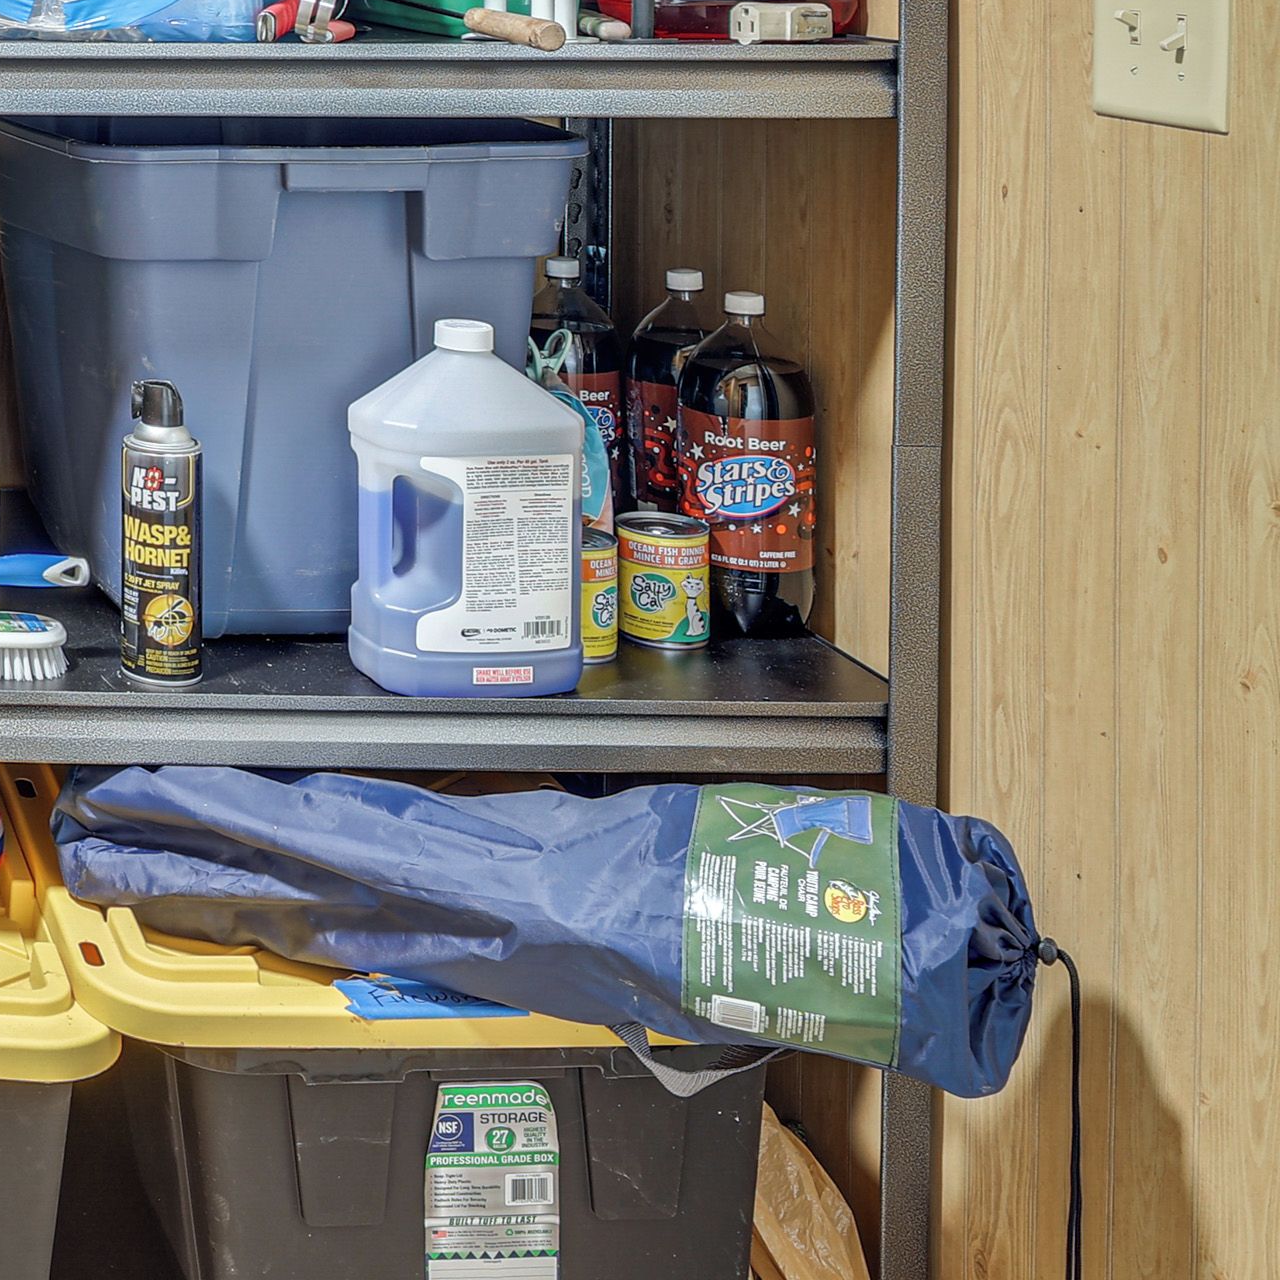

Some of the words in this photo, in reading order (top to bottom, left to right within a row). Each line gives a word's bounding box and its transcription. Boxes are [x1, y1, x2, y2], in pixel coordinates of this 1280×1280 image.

[580, 390, 610, 402] Beer
[704, 431, 744, 448] Root
[748, 438, 786, 451] Beer
[132, 466, 176, 491] NO-
[697, 460, 766, 492] Stars
[767, 458, 790, 482] &
[131, 487, 179, 512] PEST
[705, 480, 796, 515] Stripes
[124, 514, 191, 546] WASP&
[125, 538, 191, 568] HORNET
[628, 542, 655, 554] OCEAN
[659, 546, 678, 556] FISH
[634, 552, 660, 563] MINCE
[678, 556, 702, 565] GRAVY
[590, 560, 612, 568] OCEAN
[143, 579, 155, 587] JET
[156, 581, 179, 590] SPRAY
[638, 591, 663, 608] Cat
[755, 861, 767, 880] POUR
[780, 864, 789, 896] FAUTEUIL
[766, 867, 780, 902] CAMPING
[798, 879, 806, 902] CHAIR
[806, 871, 819, 892] YOUTH
[753, 880, 766, 904] JEUNE
[779, 898, 788, 910] DE
[805, 893, 818, 918] CAMP
[444, 1089, 548, 1106] reenmade
[480, 1112, 548, 1124] STORAGE
[438, 1122, 458, 1134] NSF
[492, 1130, 508, 1144] 27
[430, 1156, 499, 1166] PROFESSIONAL
[501, 1154, 532, 1164] GRADE
[534, 1154, 554, 1162] BOX
[449, 1218, 474, 1226] BUILT
[480, 1217, 500, 1225] TUFF
[516, 1216, 536, 1224] LAST
